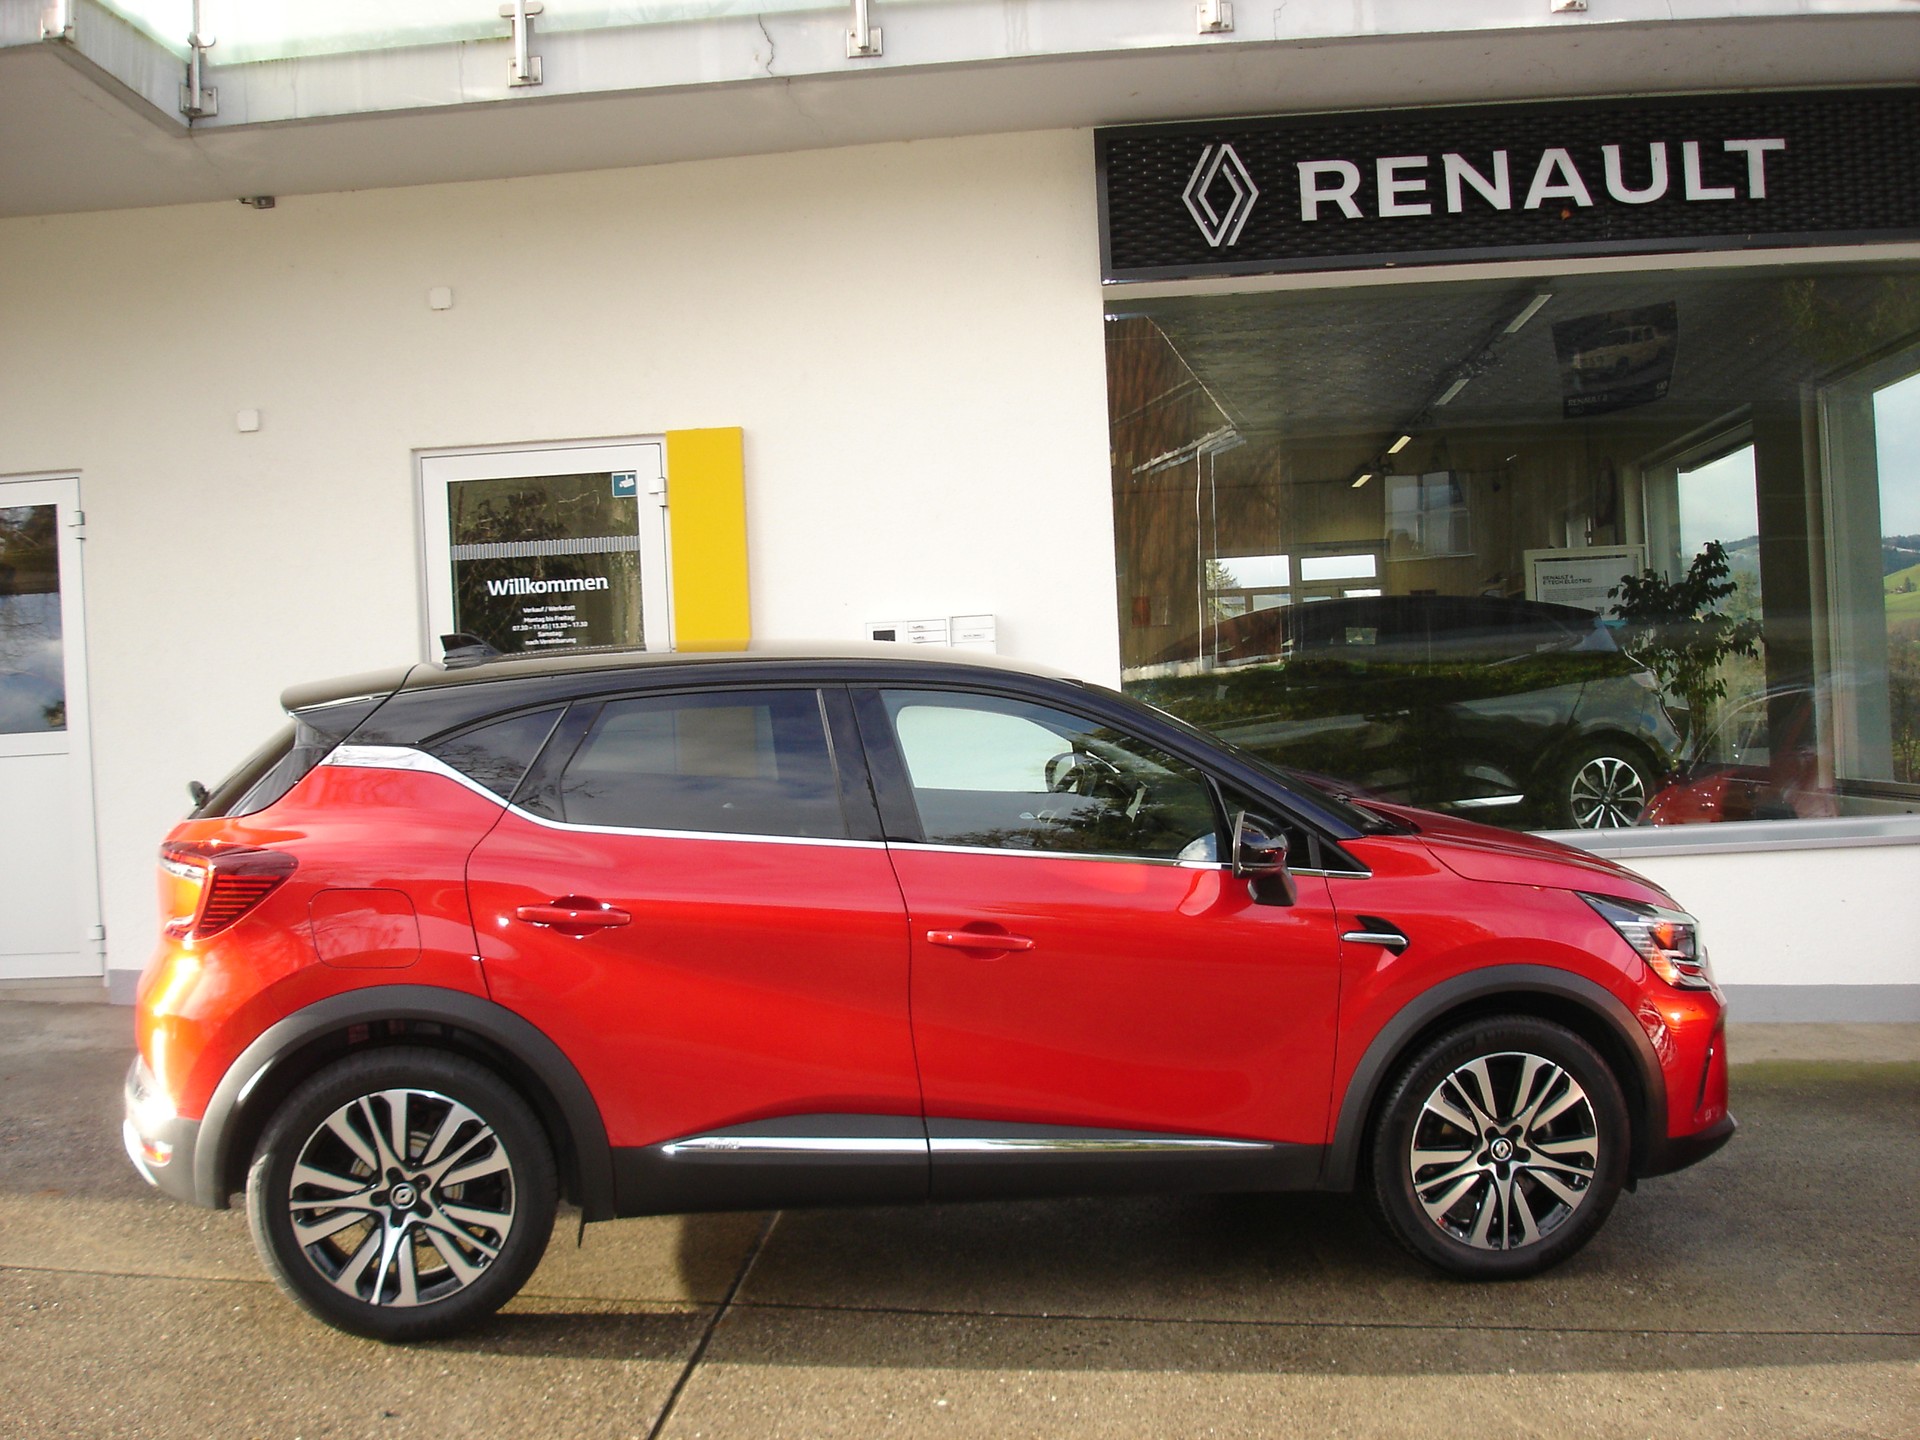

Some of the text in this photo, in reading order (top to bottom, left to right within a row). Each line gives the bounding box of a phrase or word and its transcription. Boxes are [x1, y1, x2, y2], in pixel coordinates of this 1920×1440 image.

[1296, 138, 1786, 222] RENAULT
[487, 575, 609, 597] Willkommen
[539, 637, 577, 645] Vereinbarung
